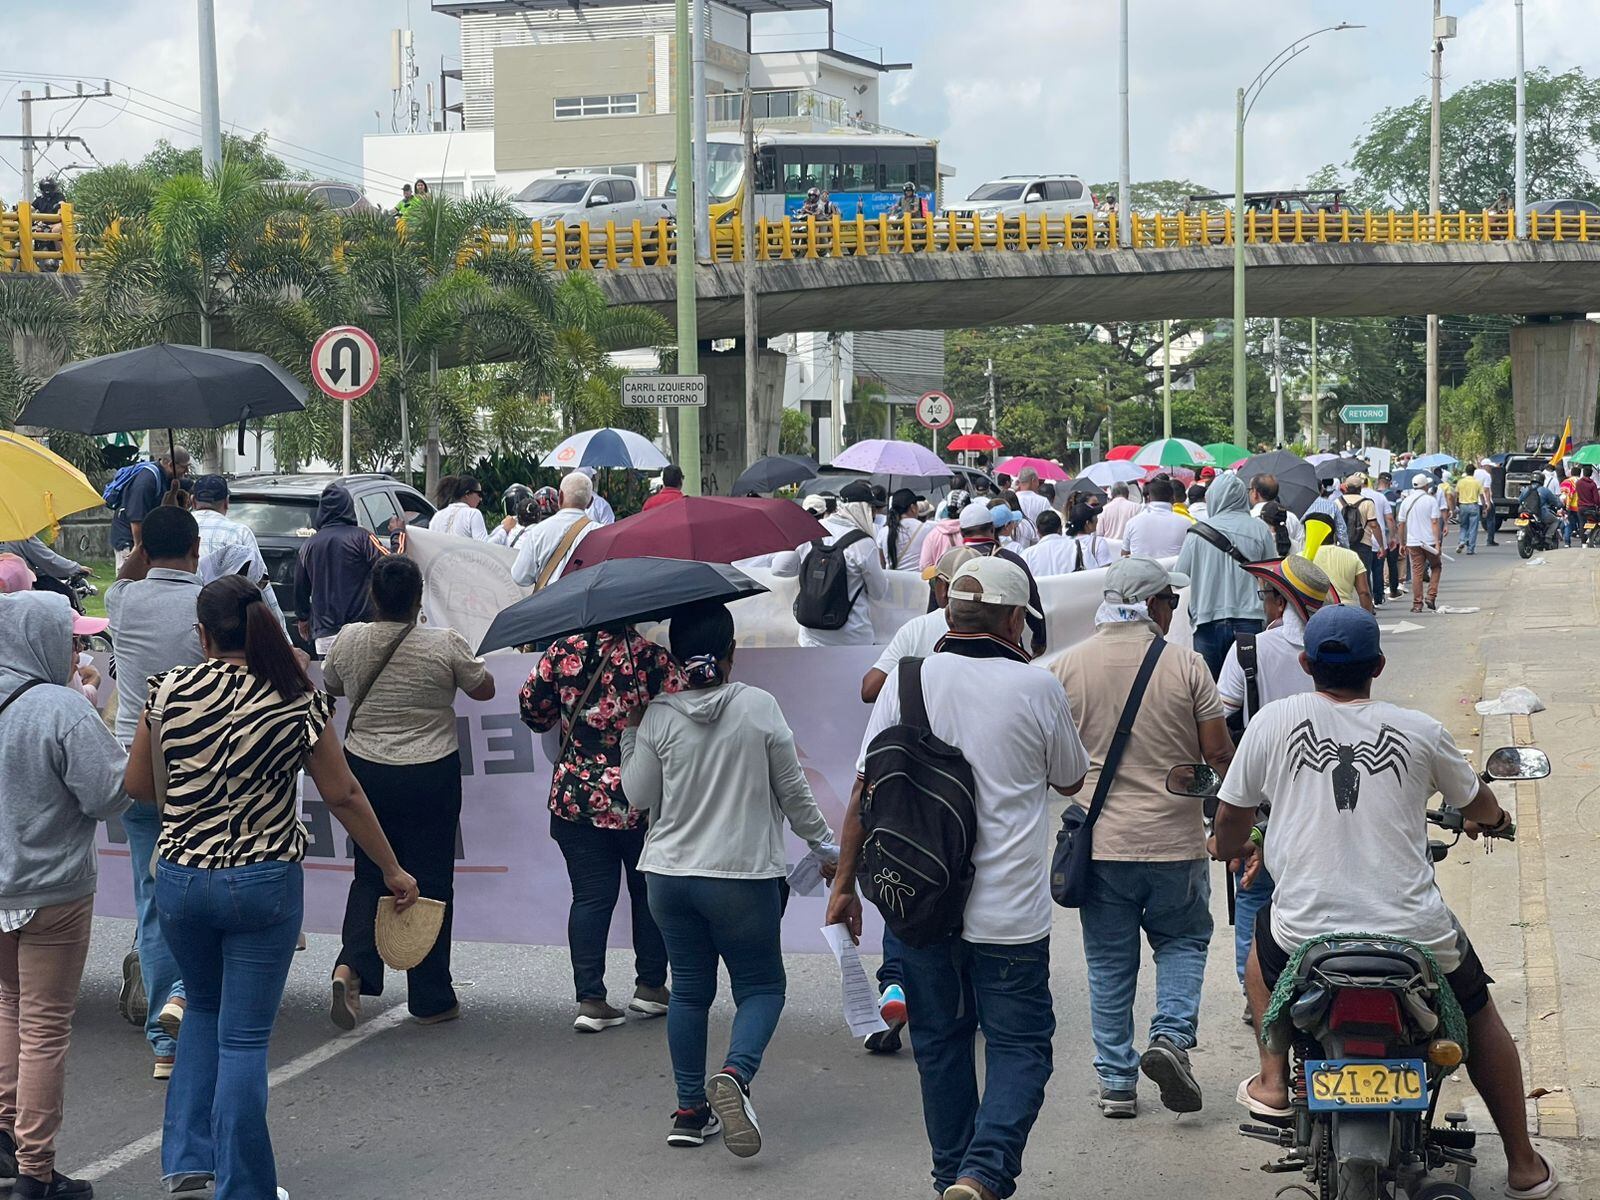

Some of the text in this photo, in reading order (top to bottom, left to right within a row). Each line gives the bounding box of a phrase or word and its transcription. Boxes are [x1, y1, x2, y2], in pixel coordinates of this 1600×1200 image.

[625, 382, 704, 392] CARRIL IZQUIERDO
[631, 394, 698, 404] SOLO RETORNO
[1348, 409, 1384, 418] RETORNO
[1313, 1069, 1420, 1097] SZI 27C
[1350, 1096, 1389, 1104] COLOMBIA
